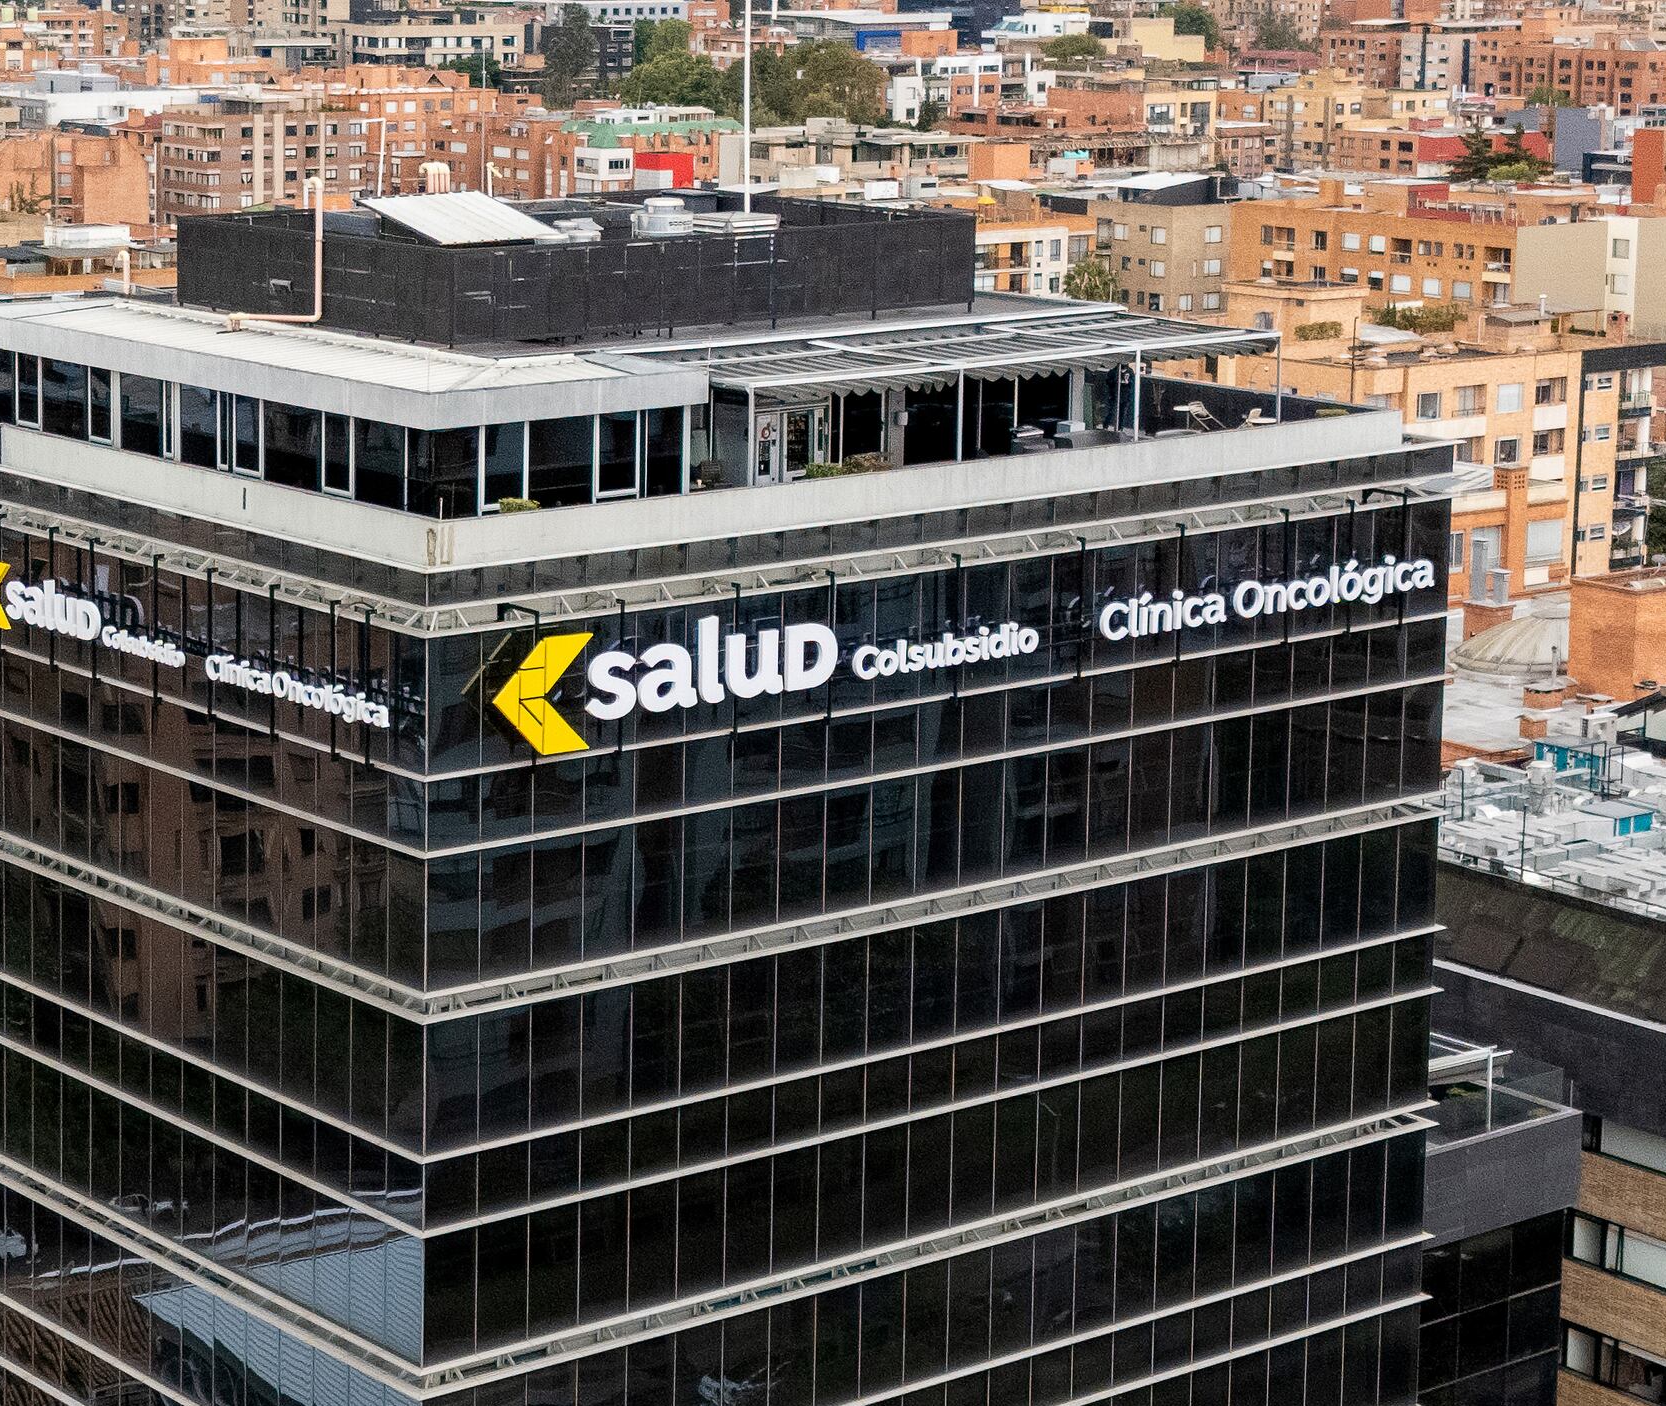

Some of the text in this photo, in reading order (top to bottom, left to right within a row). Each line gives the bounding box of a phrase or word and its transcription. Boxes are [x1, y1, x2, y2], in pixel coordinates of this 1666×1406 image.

[1099, 554, 1435, 641] Clínica Oncológica
[852, 621, 1040, 680] Colsubsidio
[205, 654, 391, 729] Clínica Oncológica
